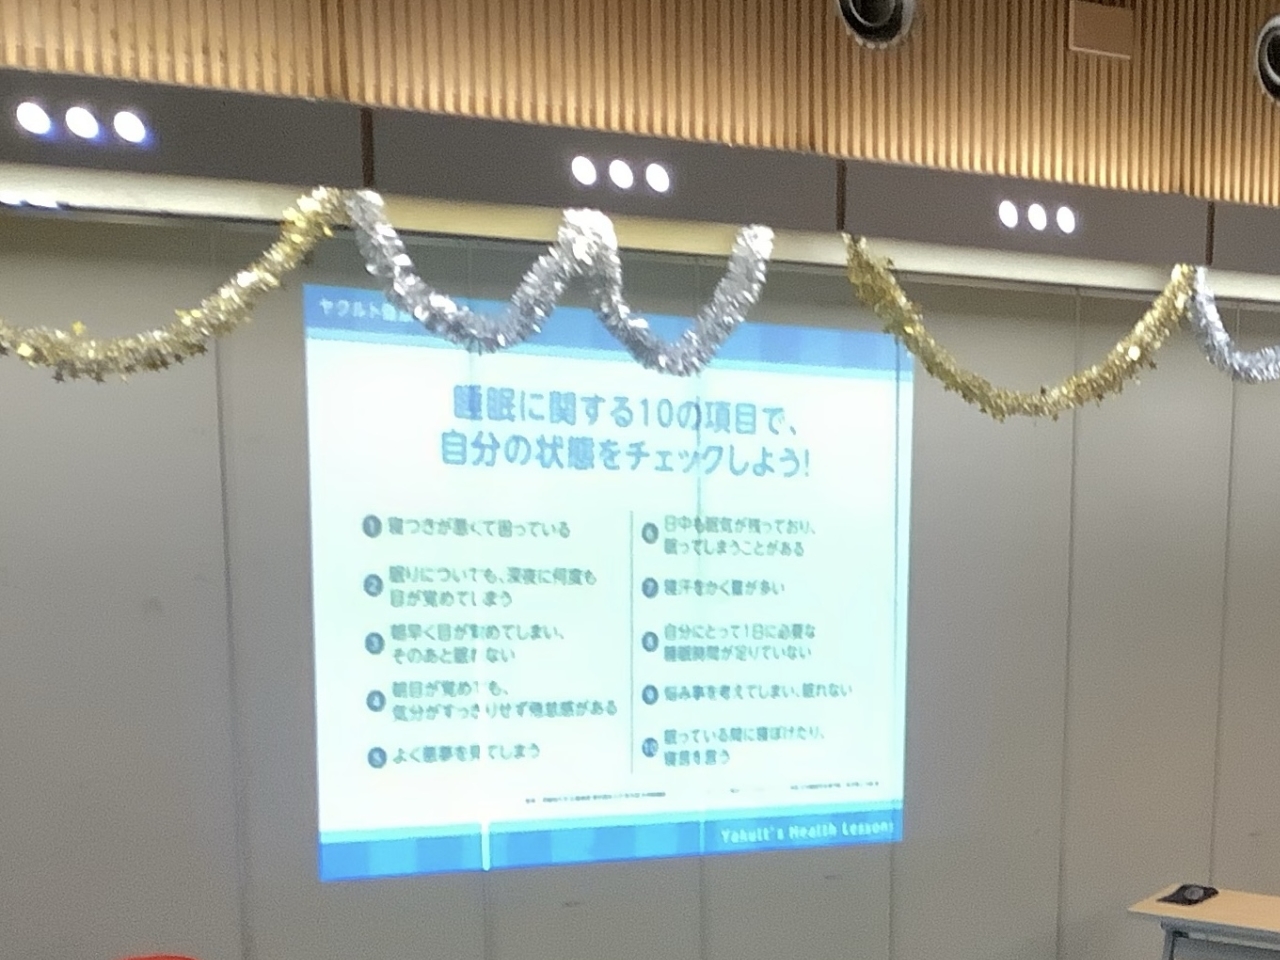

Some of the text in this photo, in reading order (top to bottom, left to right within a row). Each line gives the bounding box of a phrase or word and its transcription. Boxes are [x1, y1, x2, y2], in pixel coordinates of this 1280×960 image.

[453, 385, 798, 436] 睡眠に関する10の項目で、
[788, 822, 837, 840] Health
